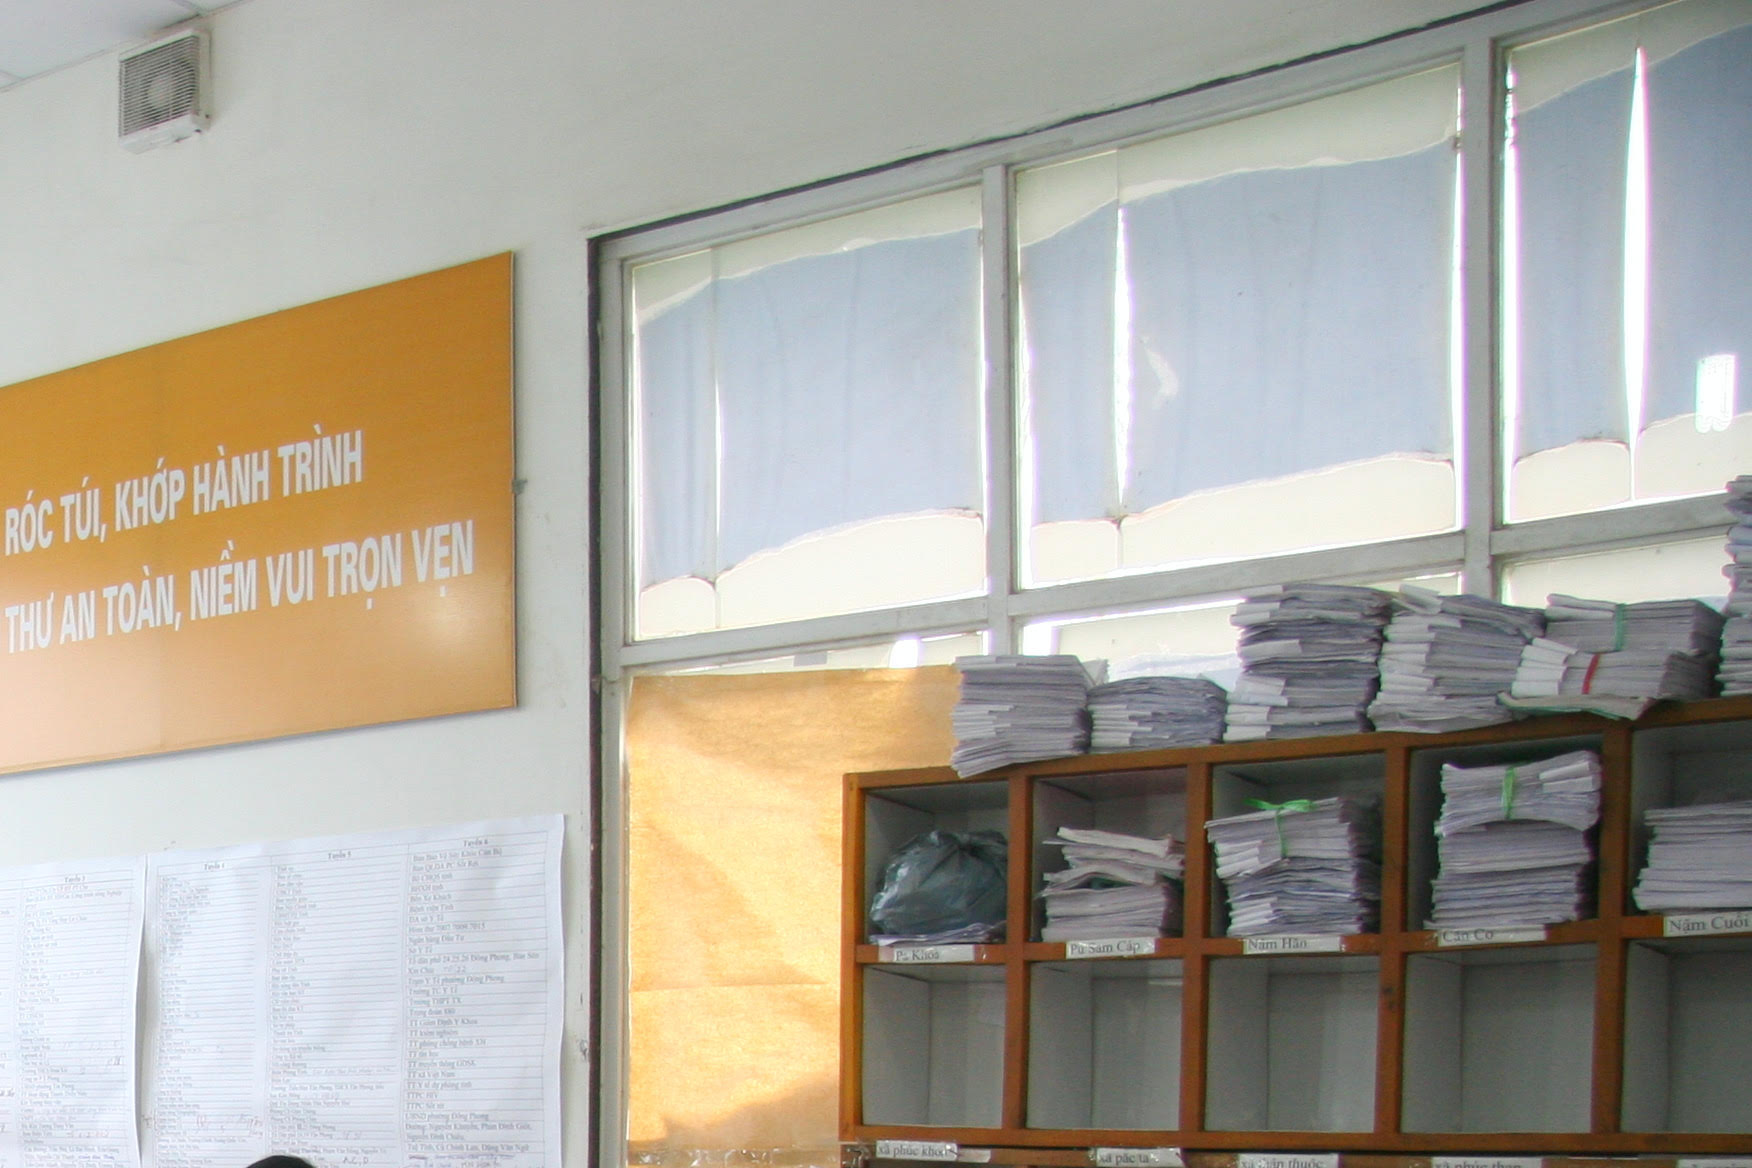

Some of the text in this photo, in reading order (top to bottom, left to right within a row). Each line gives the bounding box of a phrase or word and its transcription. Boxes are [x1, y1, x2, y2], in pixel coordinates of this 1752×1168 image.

[5, 499, 54, 556] RÓC
[61, 489, 106, 546] TÚI,
[115, 465, 185, 534] KHỚP
[192, 447, 269, 516] HÀNH
[278, 422, 363, 493] TRÌNH
[5, 590, 56, 657] THƯ
[61, 594, 95, 645] AN
[106, 572, 182, 637] TOÀN,
[189, 540, 259, 619] NIỀM
[265, 554, 313, 609] VUI
[323, 540, 402, 610] TRỌN
[409, 521, 474, 596] VẸN
